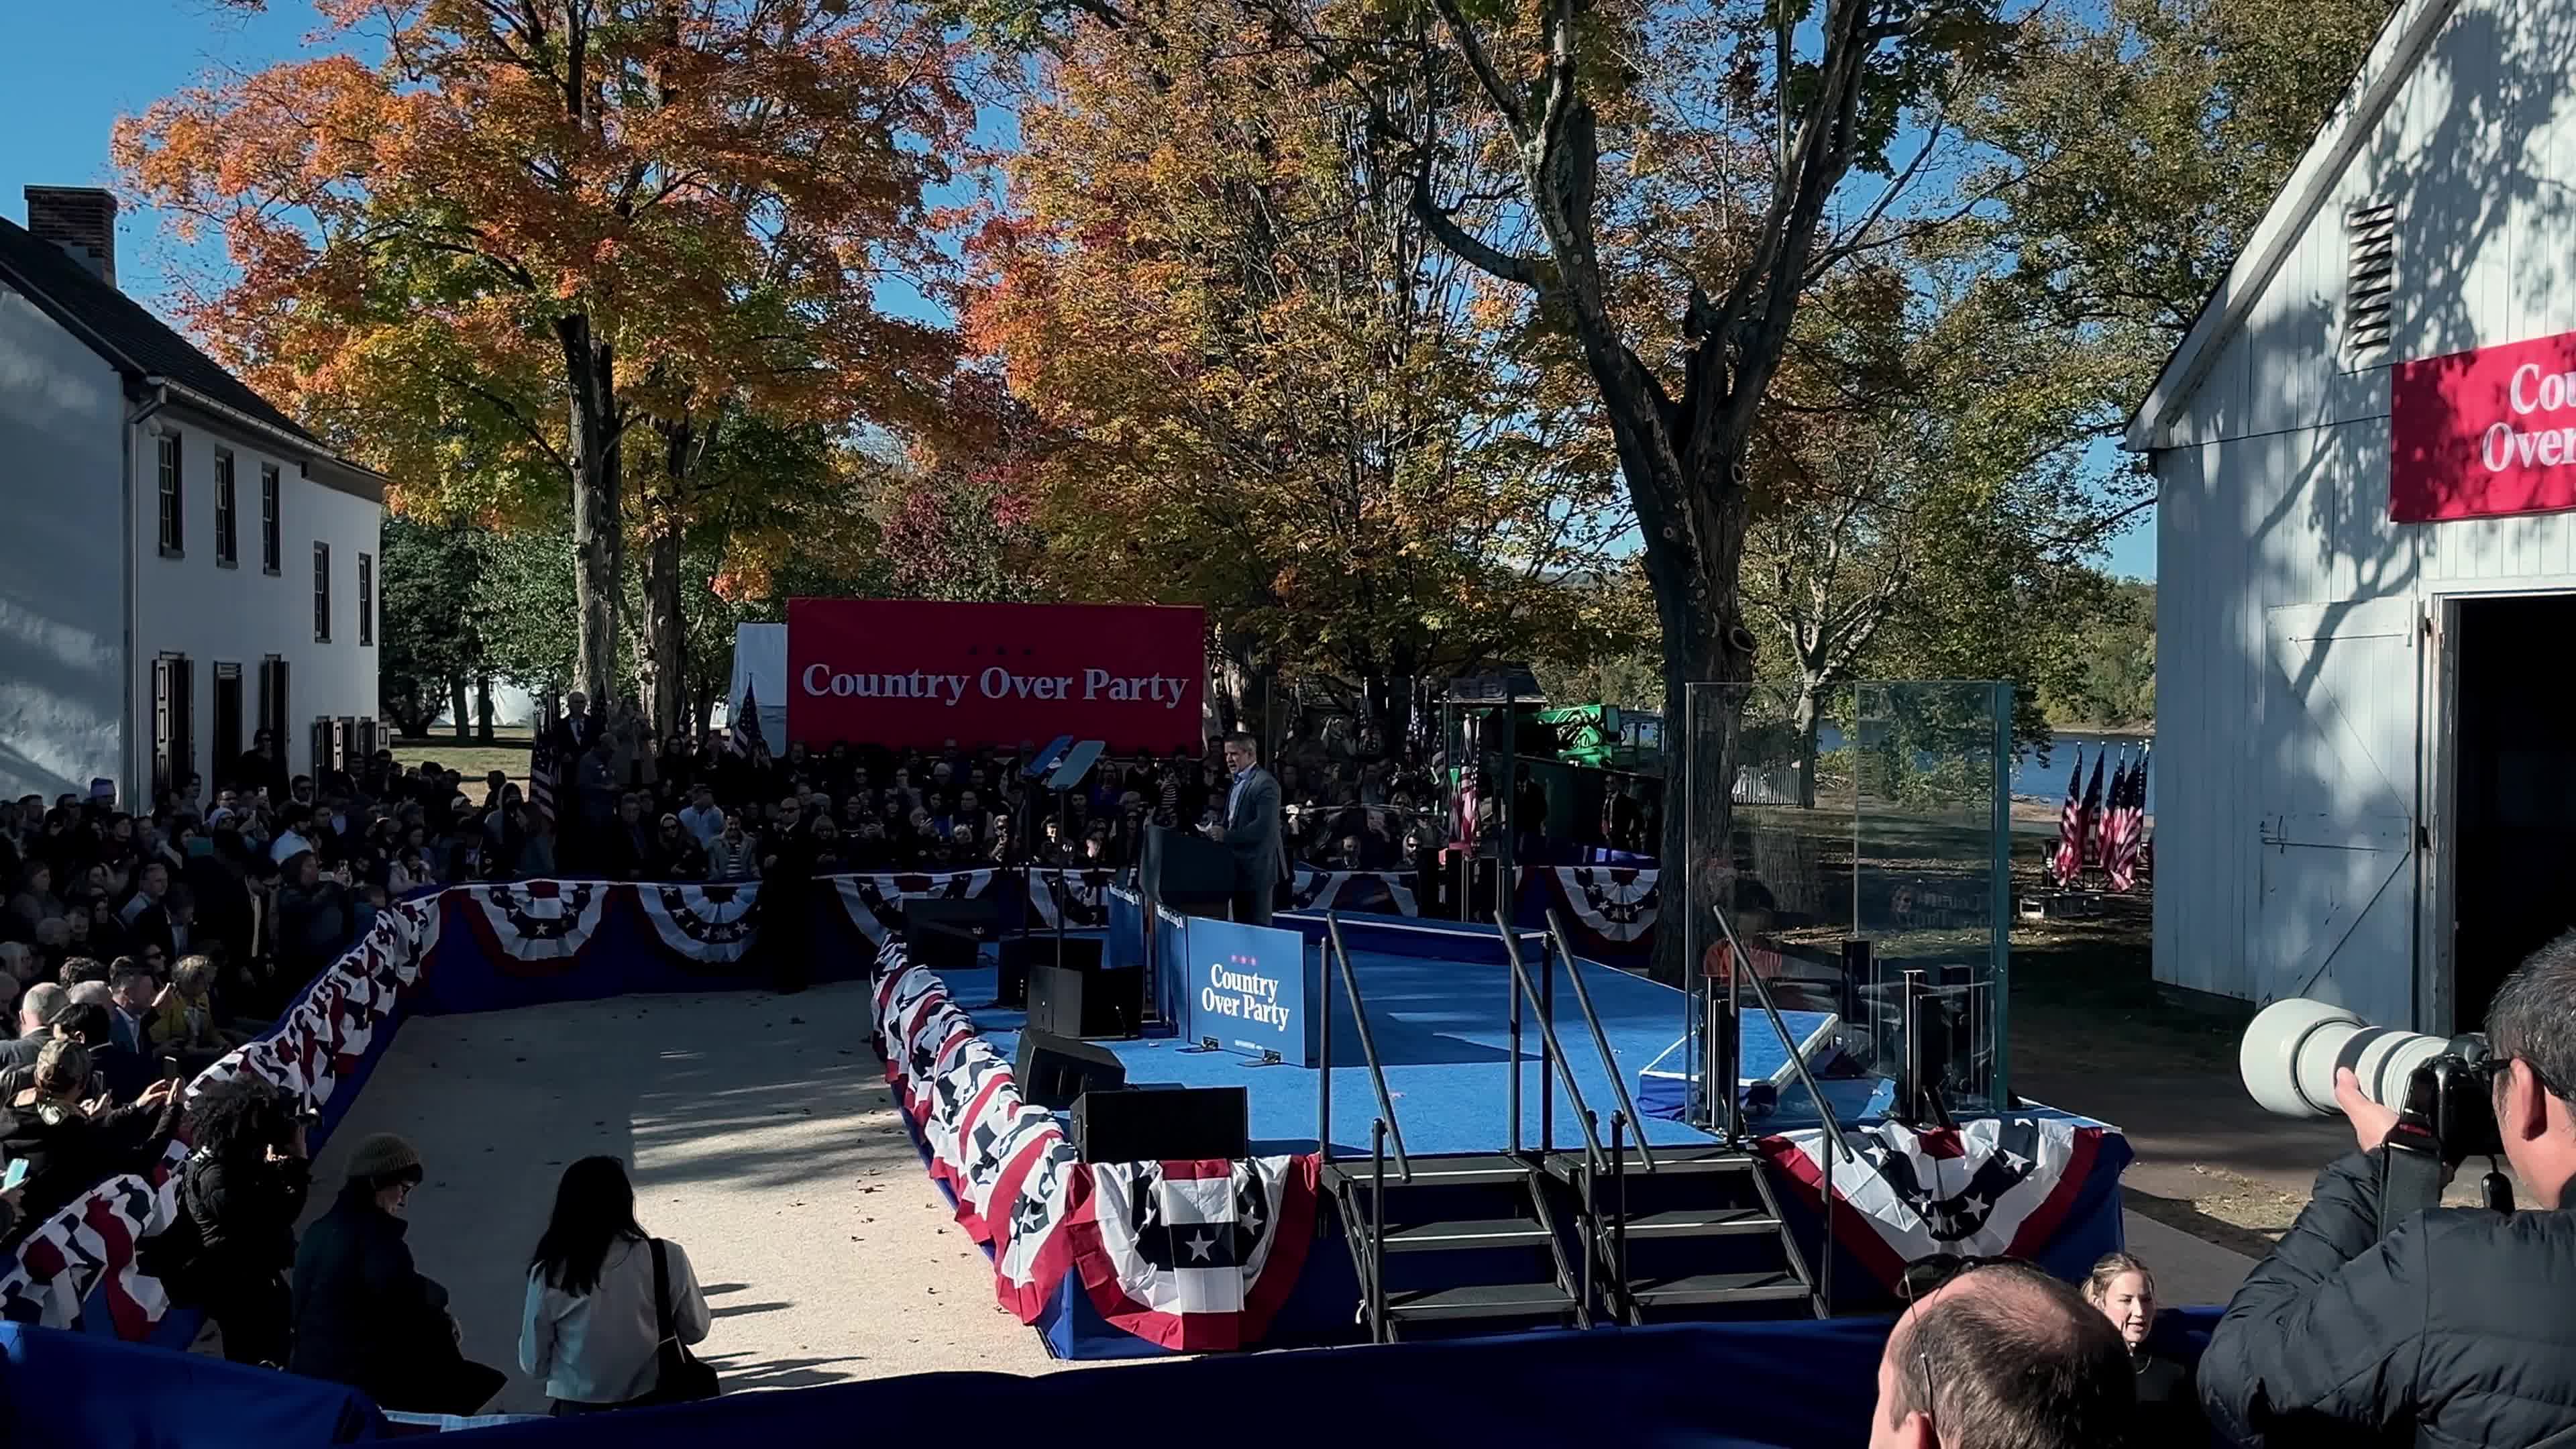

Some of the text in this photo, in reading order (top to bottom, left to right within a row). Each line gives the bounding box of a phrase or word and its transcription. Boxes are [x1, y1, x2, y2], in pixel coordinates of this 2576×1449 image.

[2483, 422, 2576, 472] Over
[803, 663, 1189, 709] Country Over Party
[1211, 963, 1279, 1003] Country
[1201, 987, 1290, 1032] Over Party
